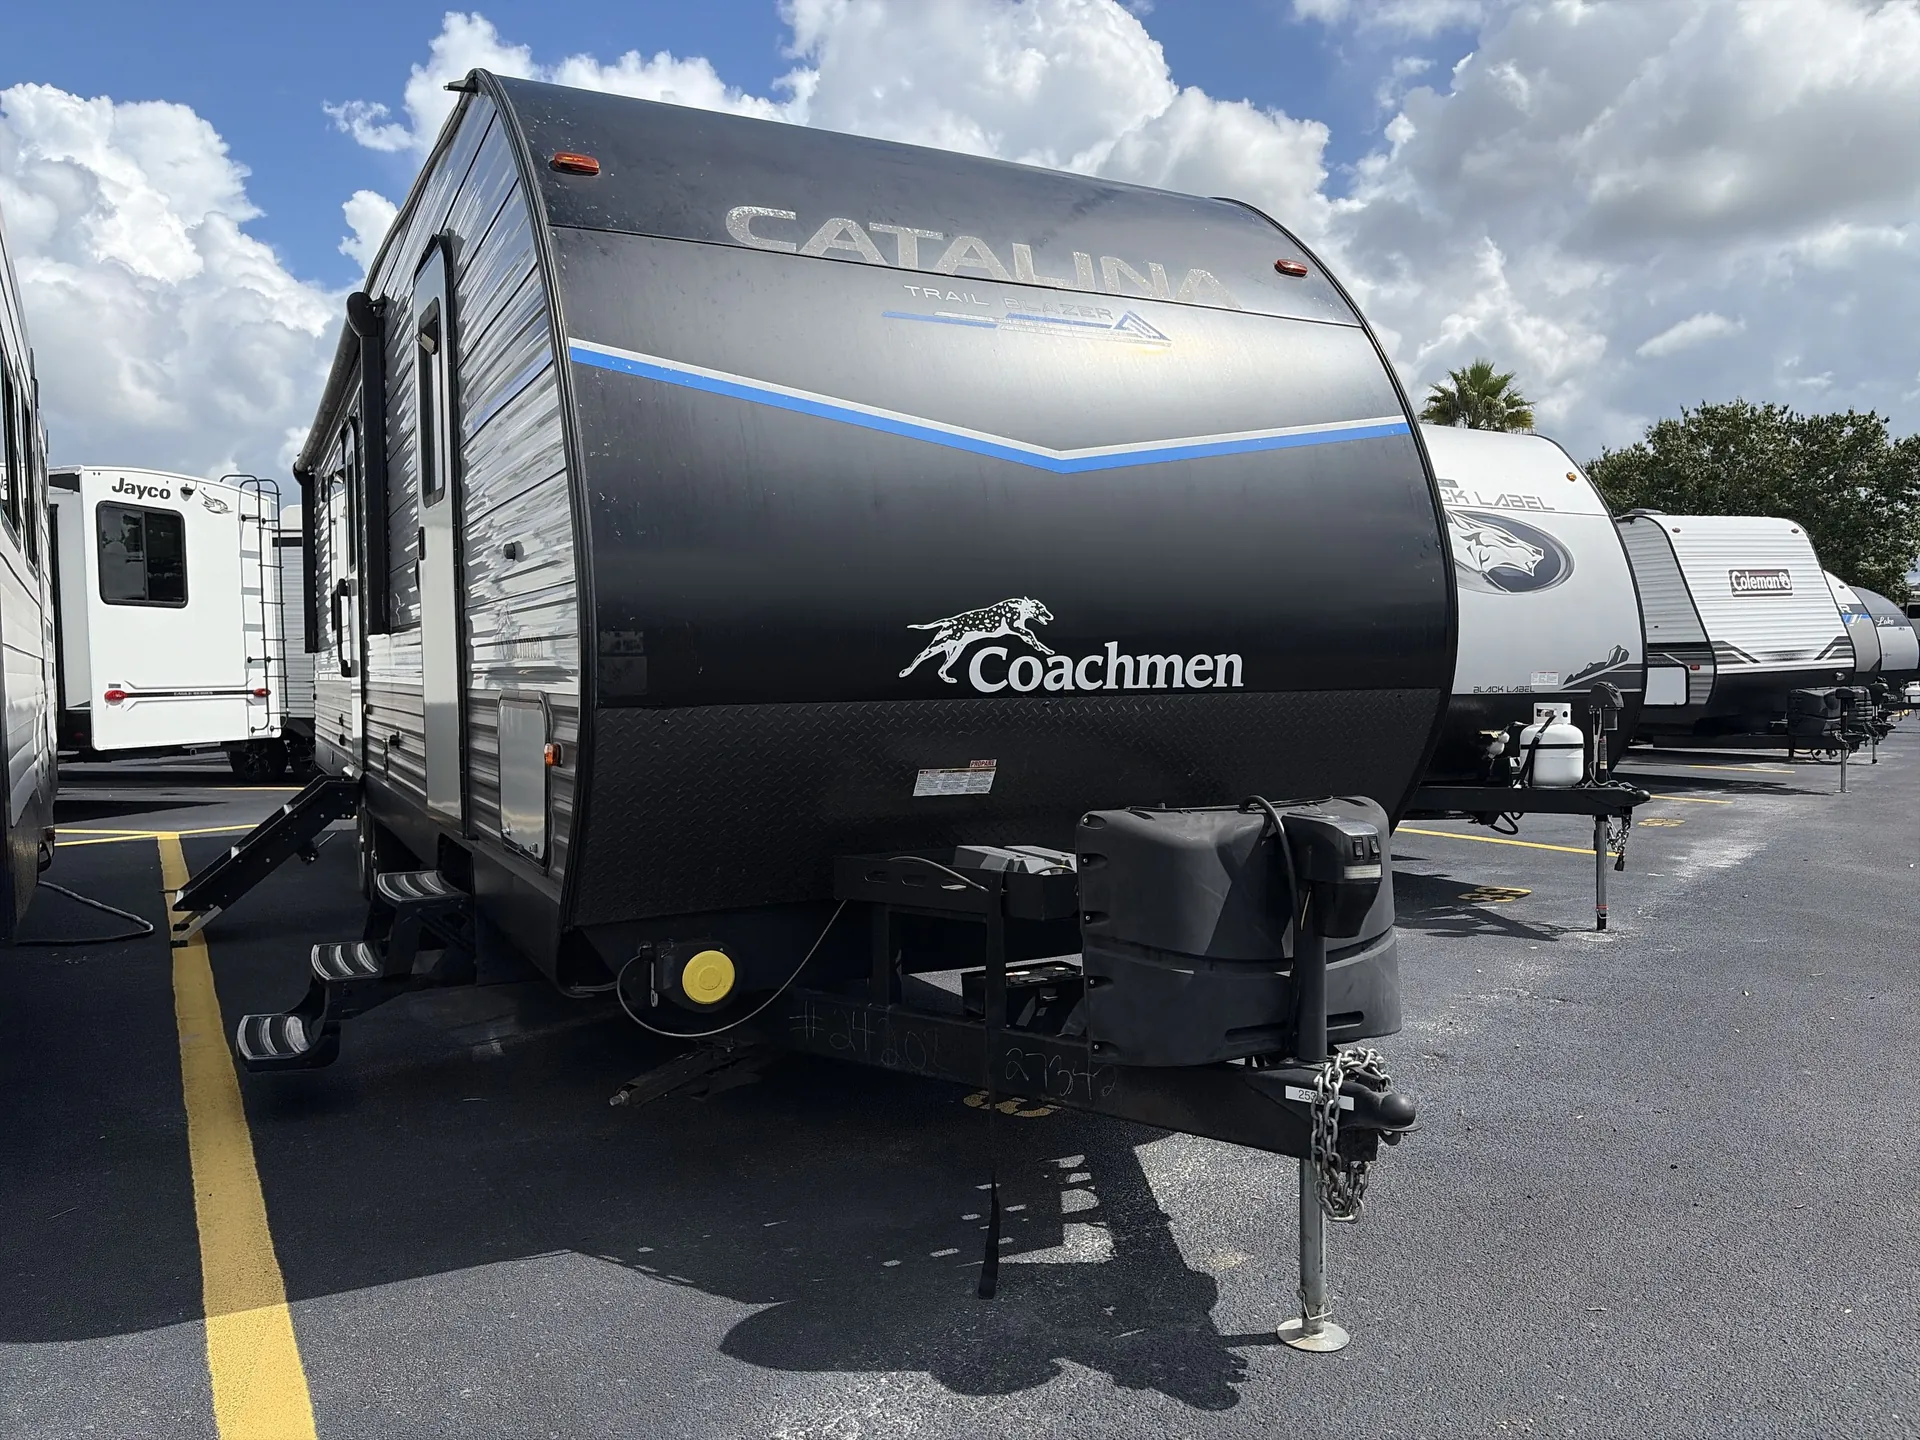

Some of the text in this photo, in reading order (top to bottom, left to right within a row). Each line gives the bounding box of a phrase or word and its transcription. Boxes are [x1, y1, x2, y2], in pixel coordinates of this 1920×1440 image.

[725, 205, 1242, 309] CATALINA
[904, 285, 1114, 320] TRAIL BLAZER
[112, 477, 171, 500] Jayco
[1474, 491, 1555, 511] LABEL
[1731, 571, 1781, 590] Coleman
[968, 641, 1244, 693] Coachmen
[1473, 685, 1535, 693] BLACK LABEL
